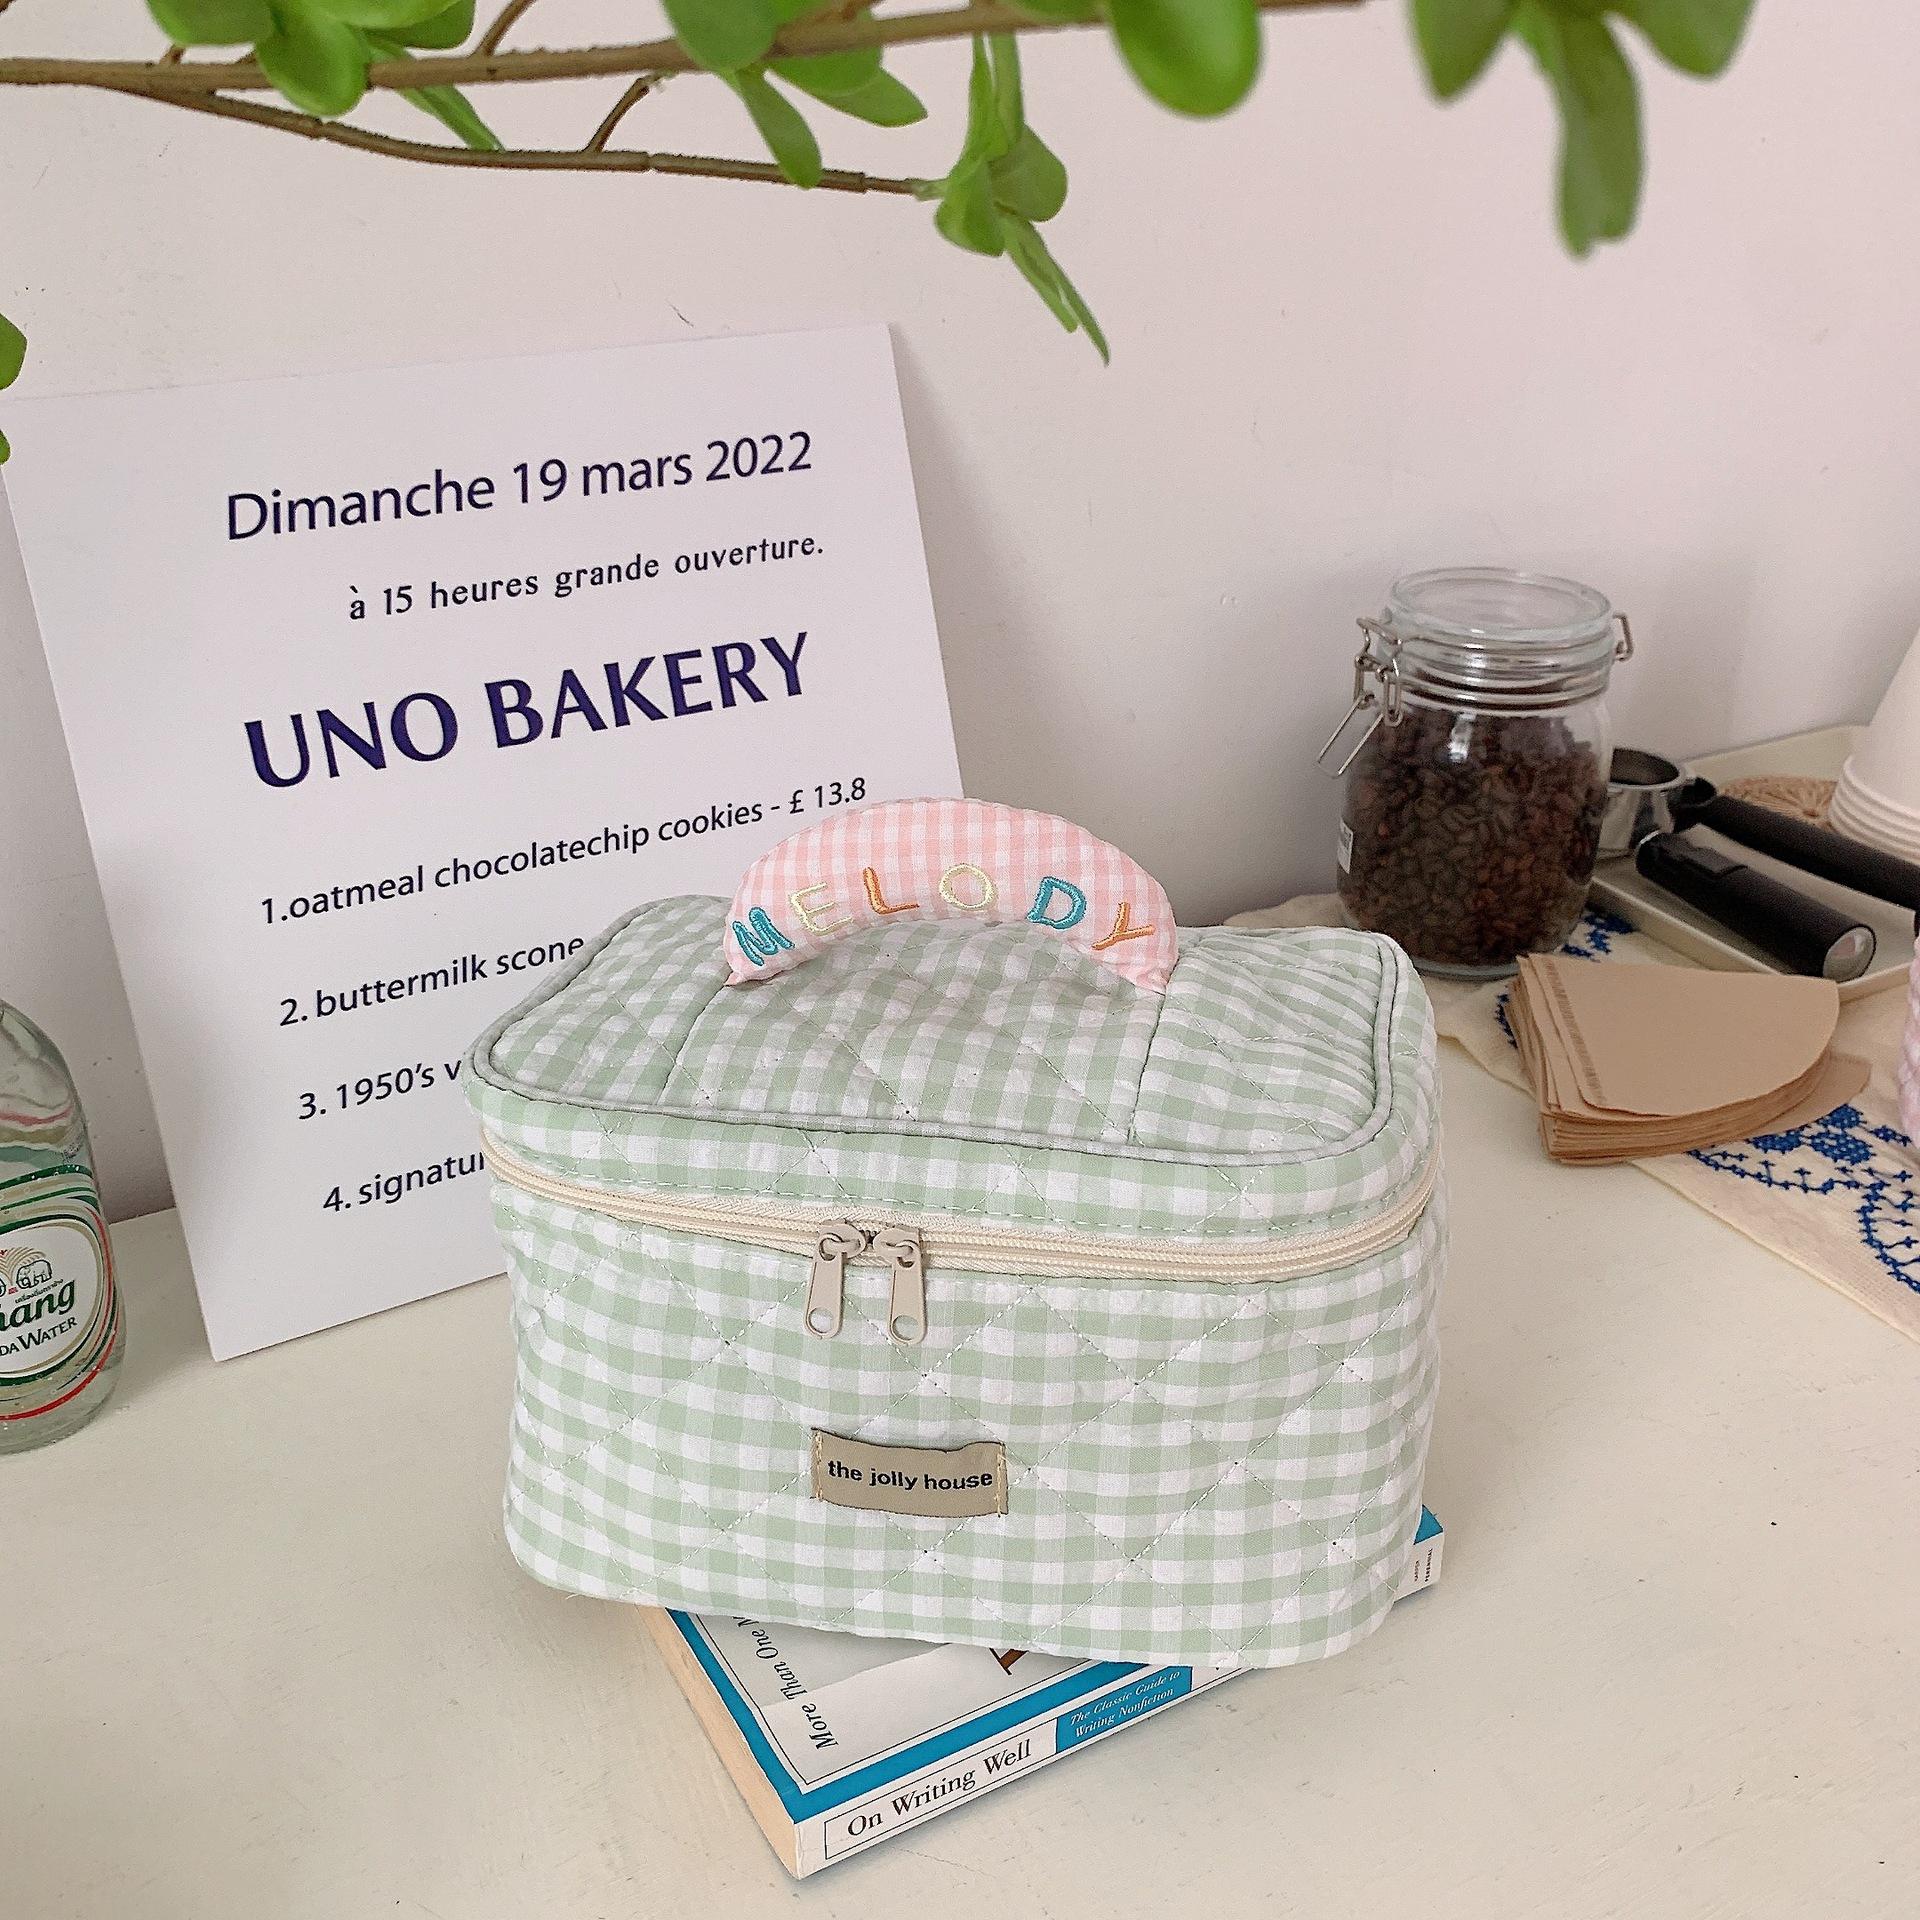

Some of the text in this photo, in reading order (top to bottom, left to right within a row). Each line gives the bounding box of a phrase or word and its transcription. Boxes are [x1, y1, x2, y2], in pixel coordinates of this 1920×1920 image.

[228, 431, 812, 541] Dimanche 19 mars 2022
[349, 538, 824, 620] à 15 heures grande ouverture.
[243, 631, 808, 788] UNO BAKERY
[261, 864, 424, 925] 1.oatmeal
[434, 823, 650, 888] chocolatechip
[658, 802, 763, 841] cookies
[788, 789, 805, 815] £
[814, 777, 866, 809] 13.8
[731, 861, 1157, 967] MELODY
[279, 998, 308, 1027] 2.
[316, 953, 488, 1018] buttermilk
[298, 1092, 327, 1120] 3.
[322, 1186, 352, 1213] 4.
[827, 1460, 993, 1491] the jolly house
[752, 1629, 779, 1660] One
[773, 1661, 808, 1700] Than
[1070, 1671, 1181, 1726] The Classic Guide to
[801, 1703, 840, 1750] More
[1074, 1687, 1175, 1739] Writing Nonfiction
[847, 1738, 1032, 1836] On Writing Well
